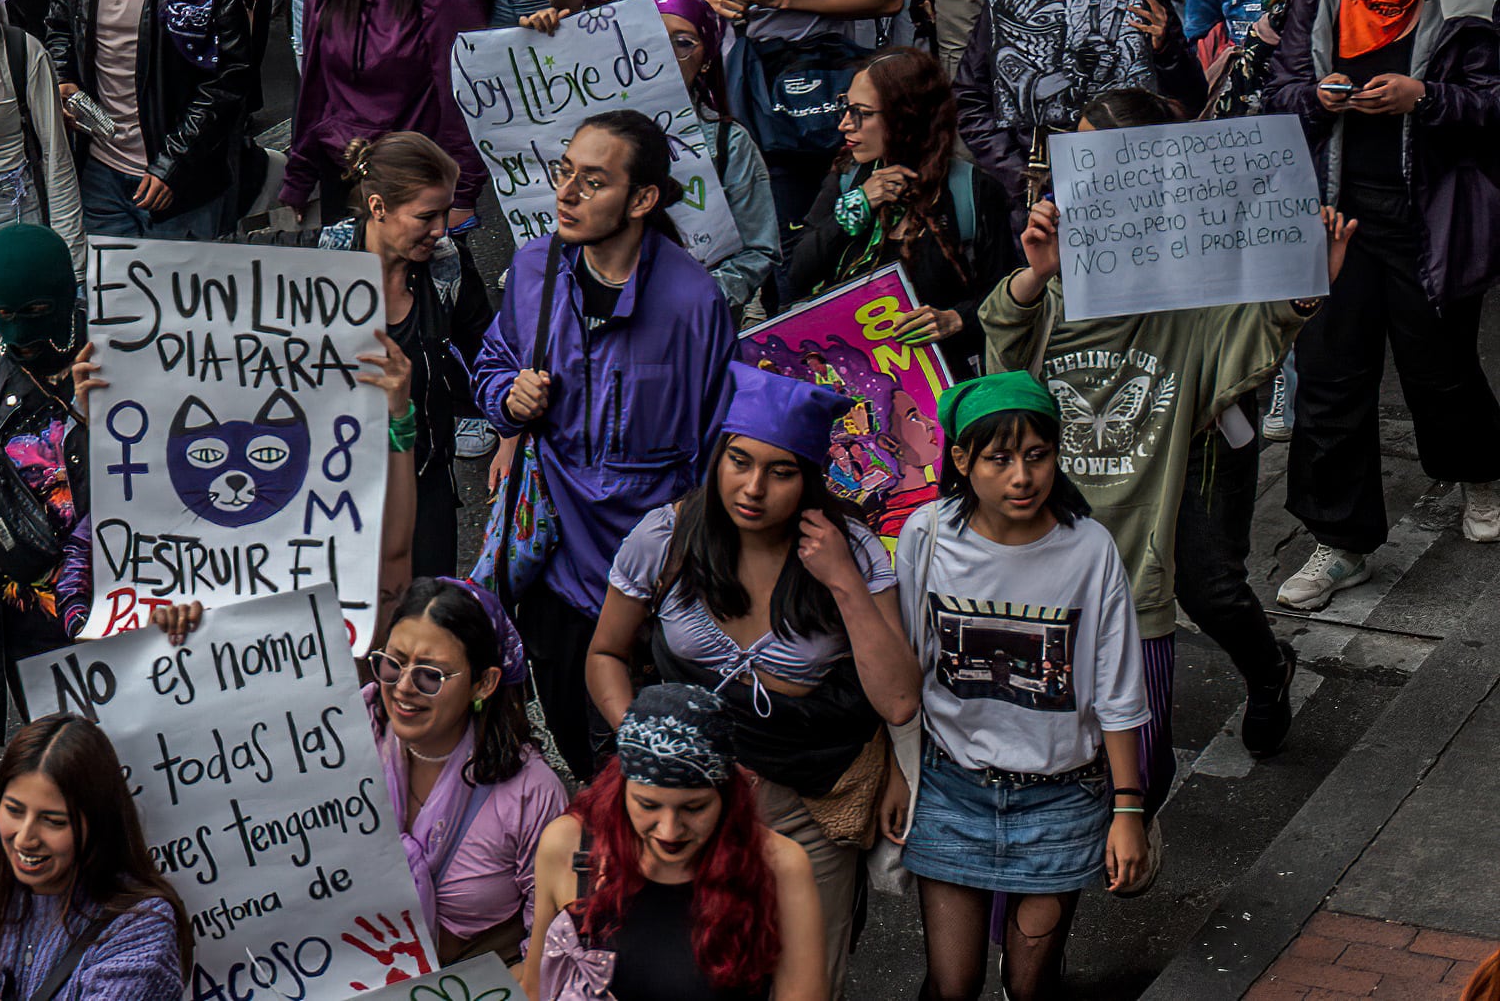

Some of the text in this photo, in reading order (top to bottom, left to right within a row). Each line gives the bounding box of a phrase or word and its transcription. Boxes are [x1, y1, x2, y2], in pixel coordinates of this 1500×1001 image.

[612, 19, 664, 88] de
[1114, 121, 1264, 167] discapacidad
[1065, 198, 1116, 224] más
[1128, 177, 1240, 215] vulnerable
[1070, 147, 1297, 201] intelectual te hace
[1197, 207, 1228, 228] tu
[1233, 196, 1322, 224] AUTISMO
[1073, 235, 1191, 277] NO es el
[88, 243, 379, 354] ES UN LINDO
[155, 329, 360, 393] DIA PARA
[1059, 455, 1136, 477] POWER
[95, 517, 280, 597] DESTRUIR
[50, 653, 117, 724] No
[146, 647, 197, 706] es
[210, 592, 334, 692] normal
[153, 706, 346, 806] todas las
[221, 776, 382, 869] tengamos
[307, 865, 354, 902] de
